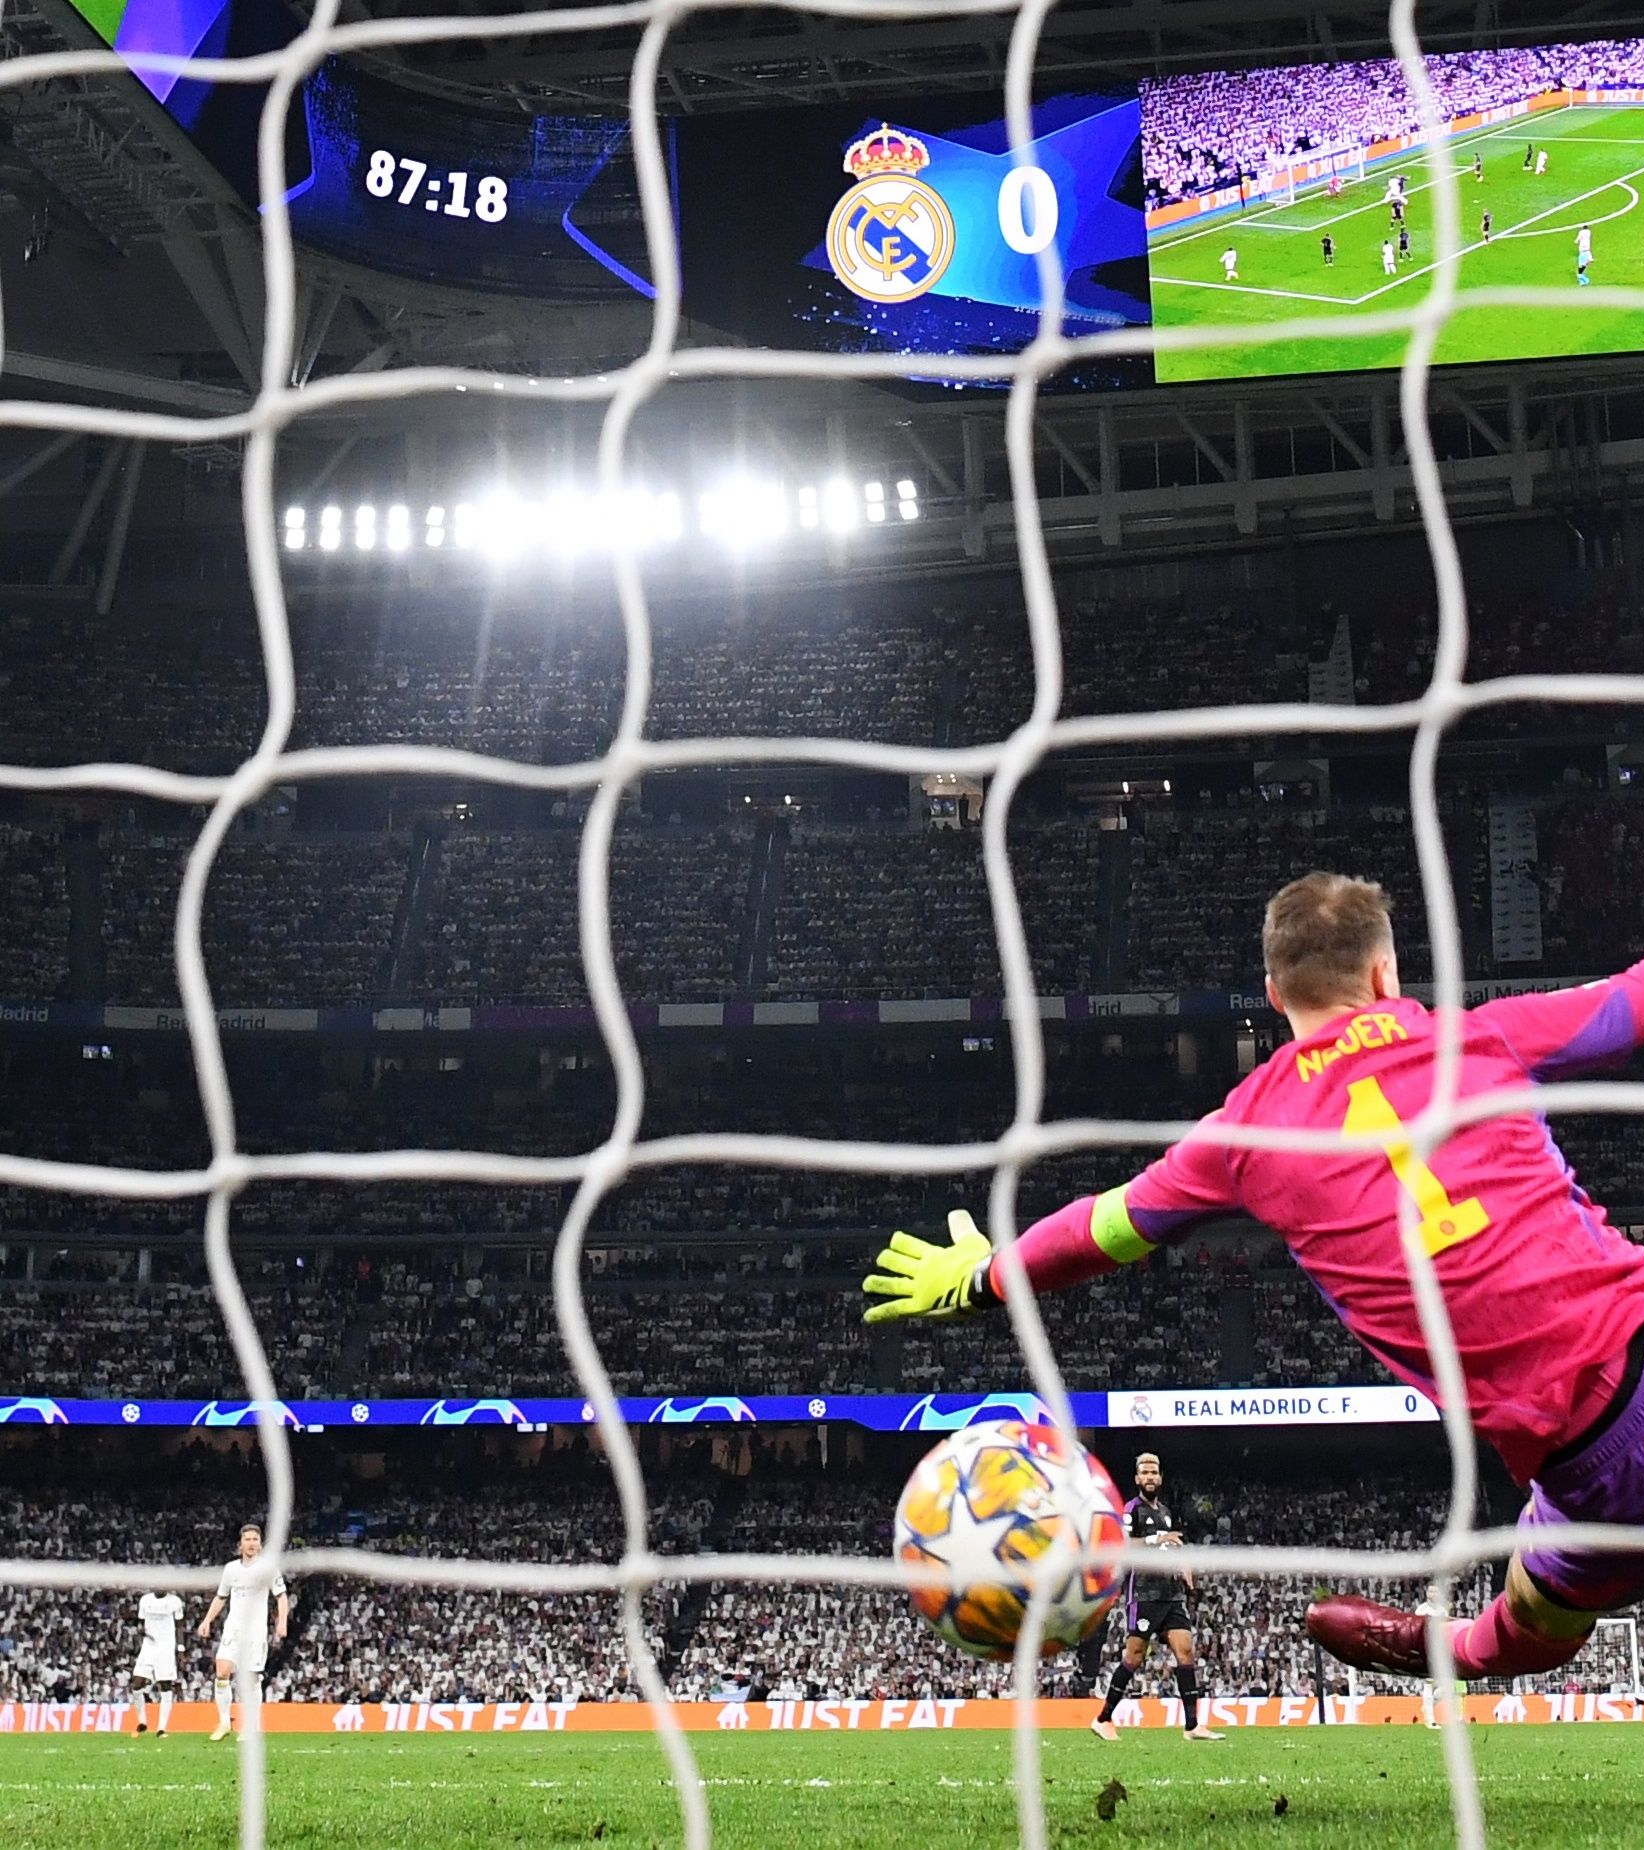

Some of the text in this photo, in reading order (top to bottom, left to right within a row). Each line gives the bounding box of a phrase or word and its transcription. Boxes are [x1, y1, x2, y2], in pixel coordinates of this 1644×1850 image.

[366, 150, 508, 223] 87:18
[997, 165, 1059, 255] 0
[1464, 987, 1489, 1002] eal
[0, 1004, 49, 1022] adrid
[216, 1013, 266, 1030] adrid
[1340, 1075, 1492, 1257] 1
[1174, 1399, 1223, 1416] REAL
[1230, 1398, 1312, 1416] MADRID
[1405, 1395, 1418, 1413] 0
[22, 1702, 131, 1732] JUST EAT
[381, 1701, 577, 1731] JUST EAT
[765, 1699, 966, 1729] JUST EAT
